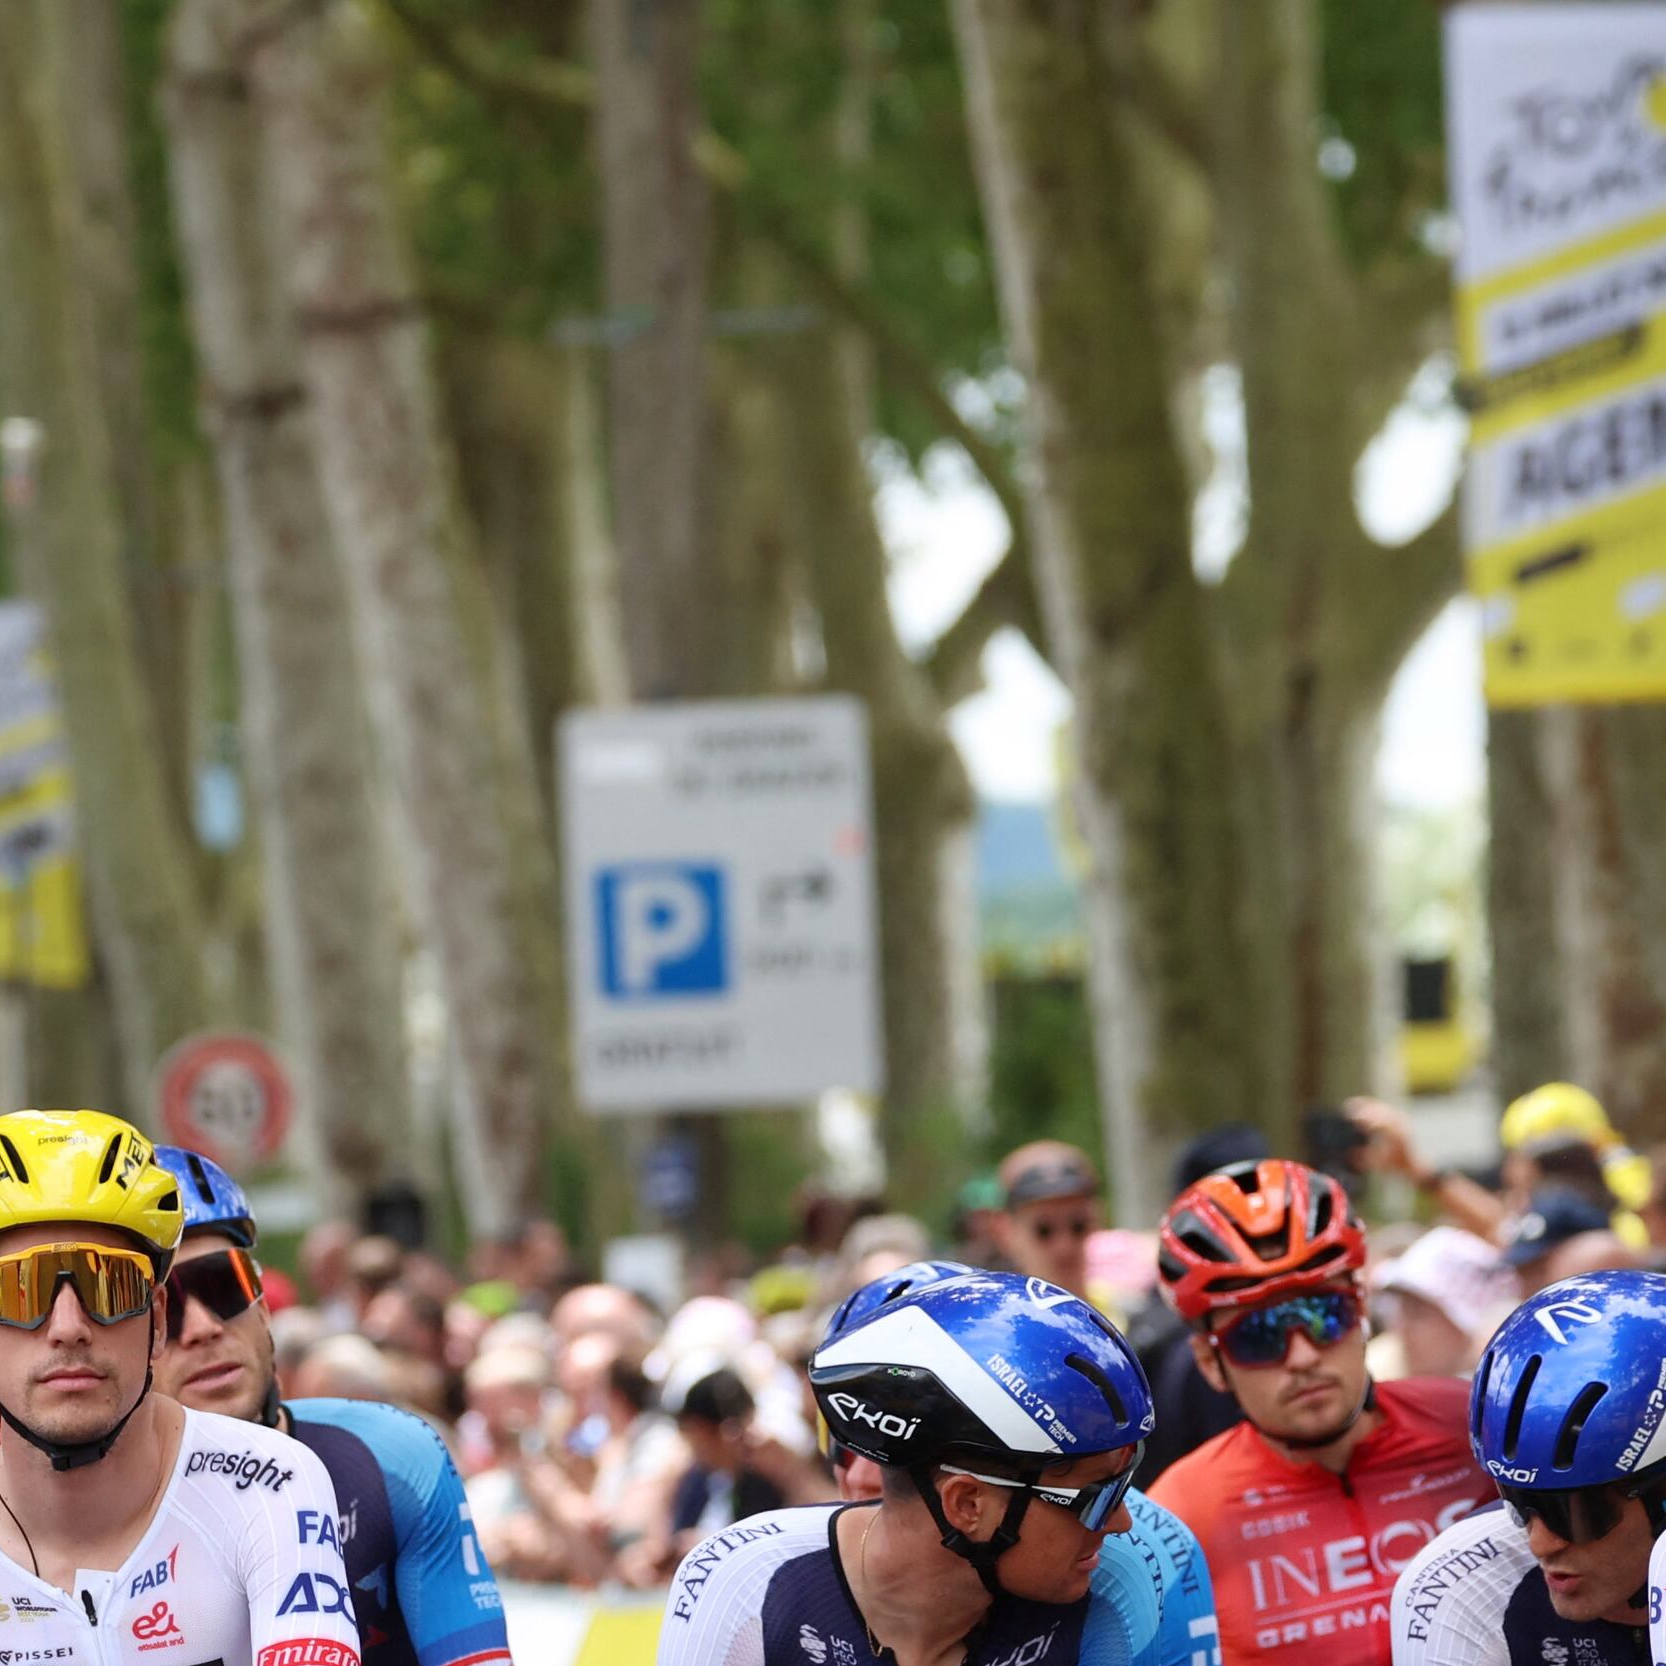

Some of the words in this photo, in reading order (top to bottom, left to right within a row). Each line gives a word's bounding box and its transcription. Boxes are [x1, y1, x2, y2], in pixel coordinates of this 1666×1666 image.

[986, 1353, 1028, 1401] ISRAEL
[1047, 1425, 1065, 1442] TECH
[1050, 1417, 1078, 1445] PREMIER
[1615, 1425, 1653, 1473] ISRAEL
[185, 1448, 295, 1494] presight
[129, 1561, 169, 1599] FAB
[673, 1520, 786, 1625] FANTINI
[12, 1597, 31, 1606] UCI
[1406, 1536, 1504, 1644] FANTINI
[15, 1646, 74, 1662] PISSEI
[137, 1640, 168, 1652] etisalat
[830, 1634, 854, 1654] UCI
[1572, 1637, 1598, 1649] UCI
[832, 1647, 858, 1666] PRO
